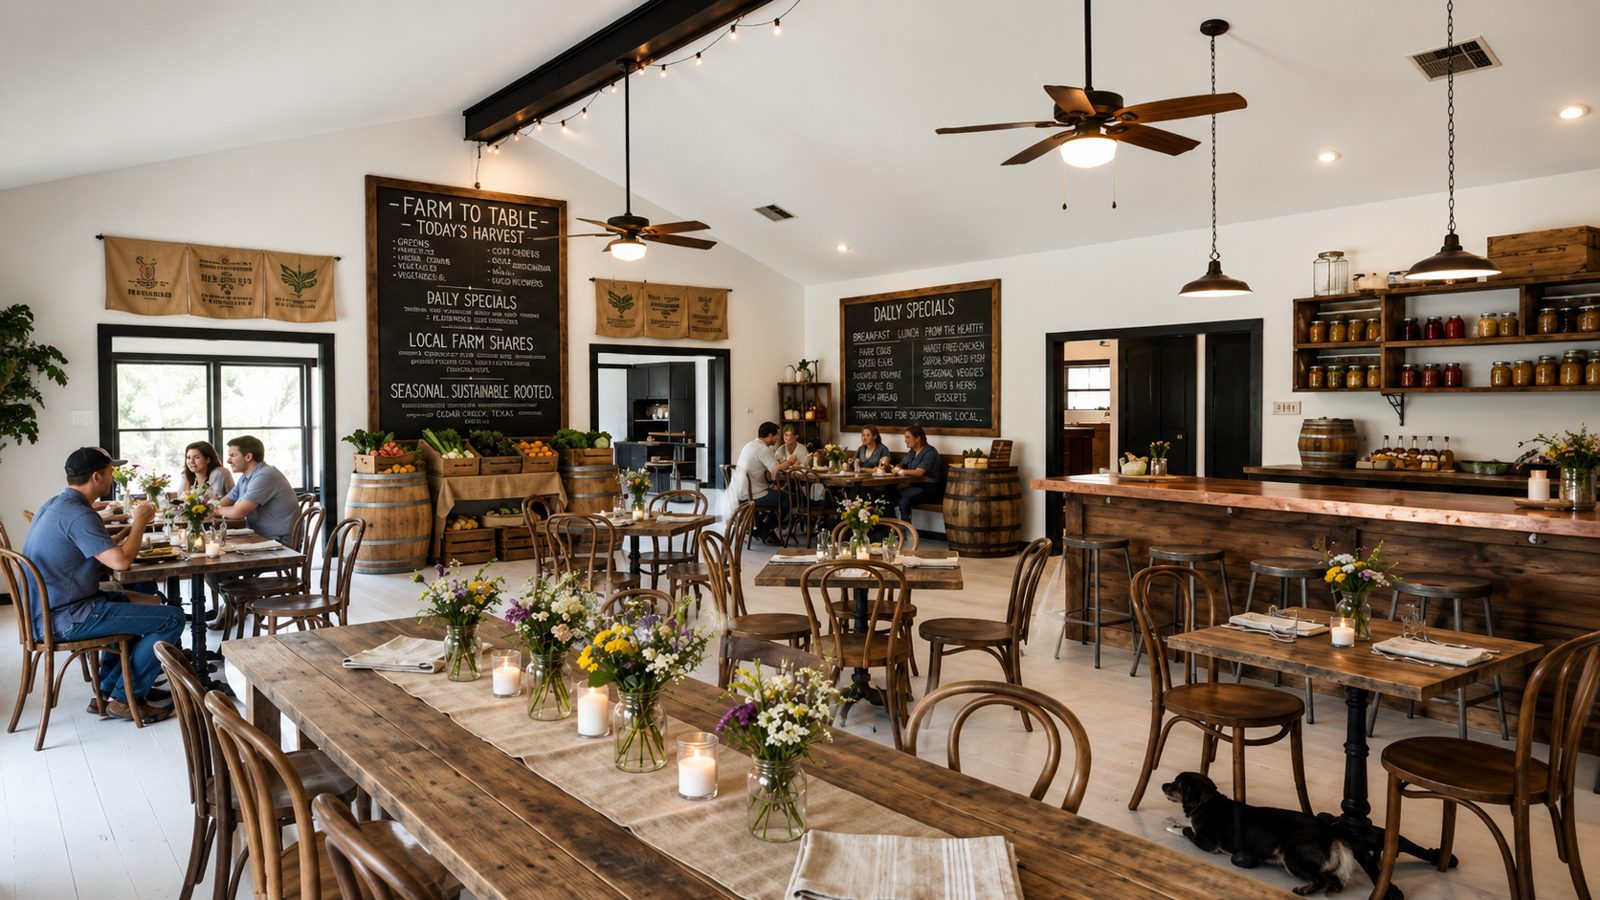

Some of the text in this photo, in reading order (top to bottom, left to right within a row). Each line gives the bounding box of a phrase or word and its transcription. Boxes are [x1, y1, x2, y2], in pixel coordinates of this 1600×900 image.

[403, 196, 539, 230] FARM TO TABLE
[416, 219, 525, 244] TODAY'S HARVEST
[427, 290, 518, 310] DAILY SPECIALS
[906, 297, 955, 319] SPECIALS
[408, 332, 534, 352] LOCAL FARM SHARES
